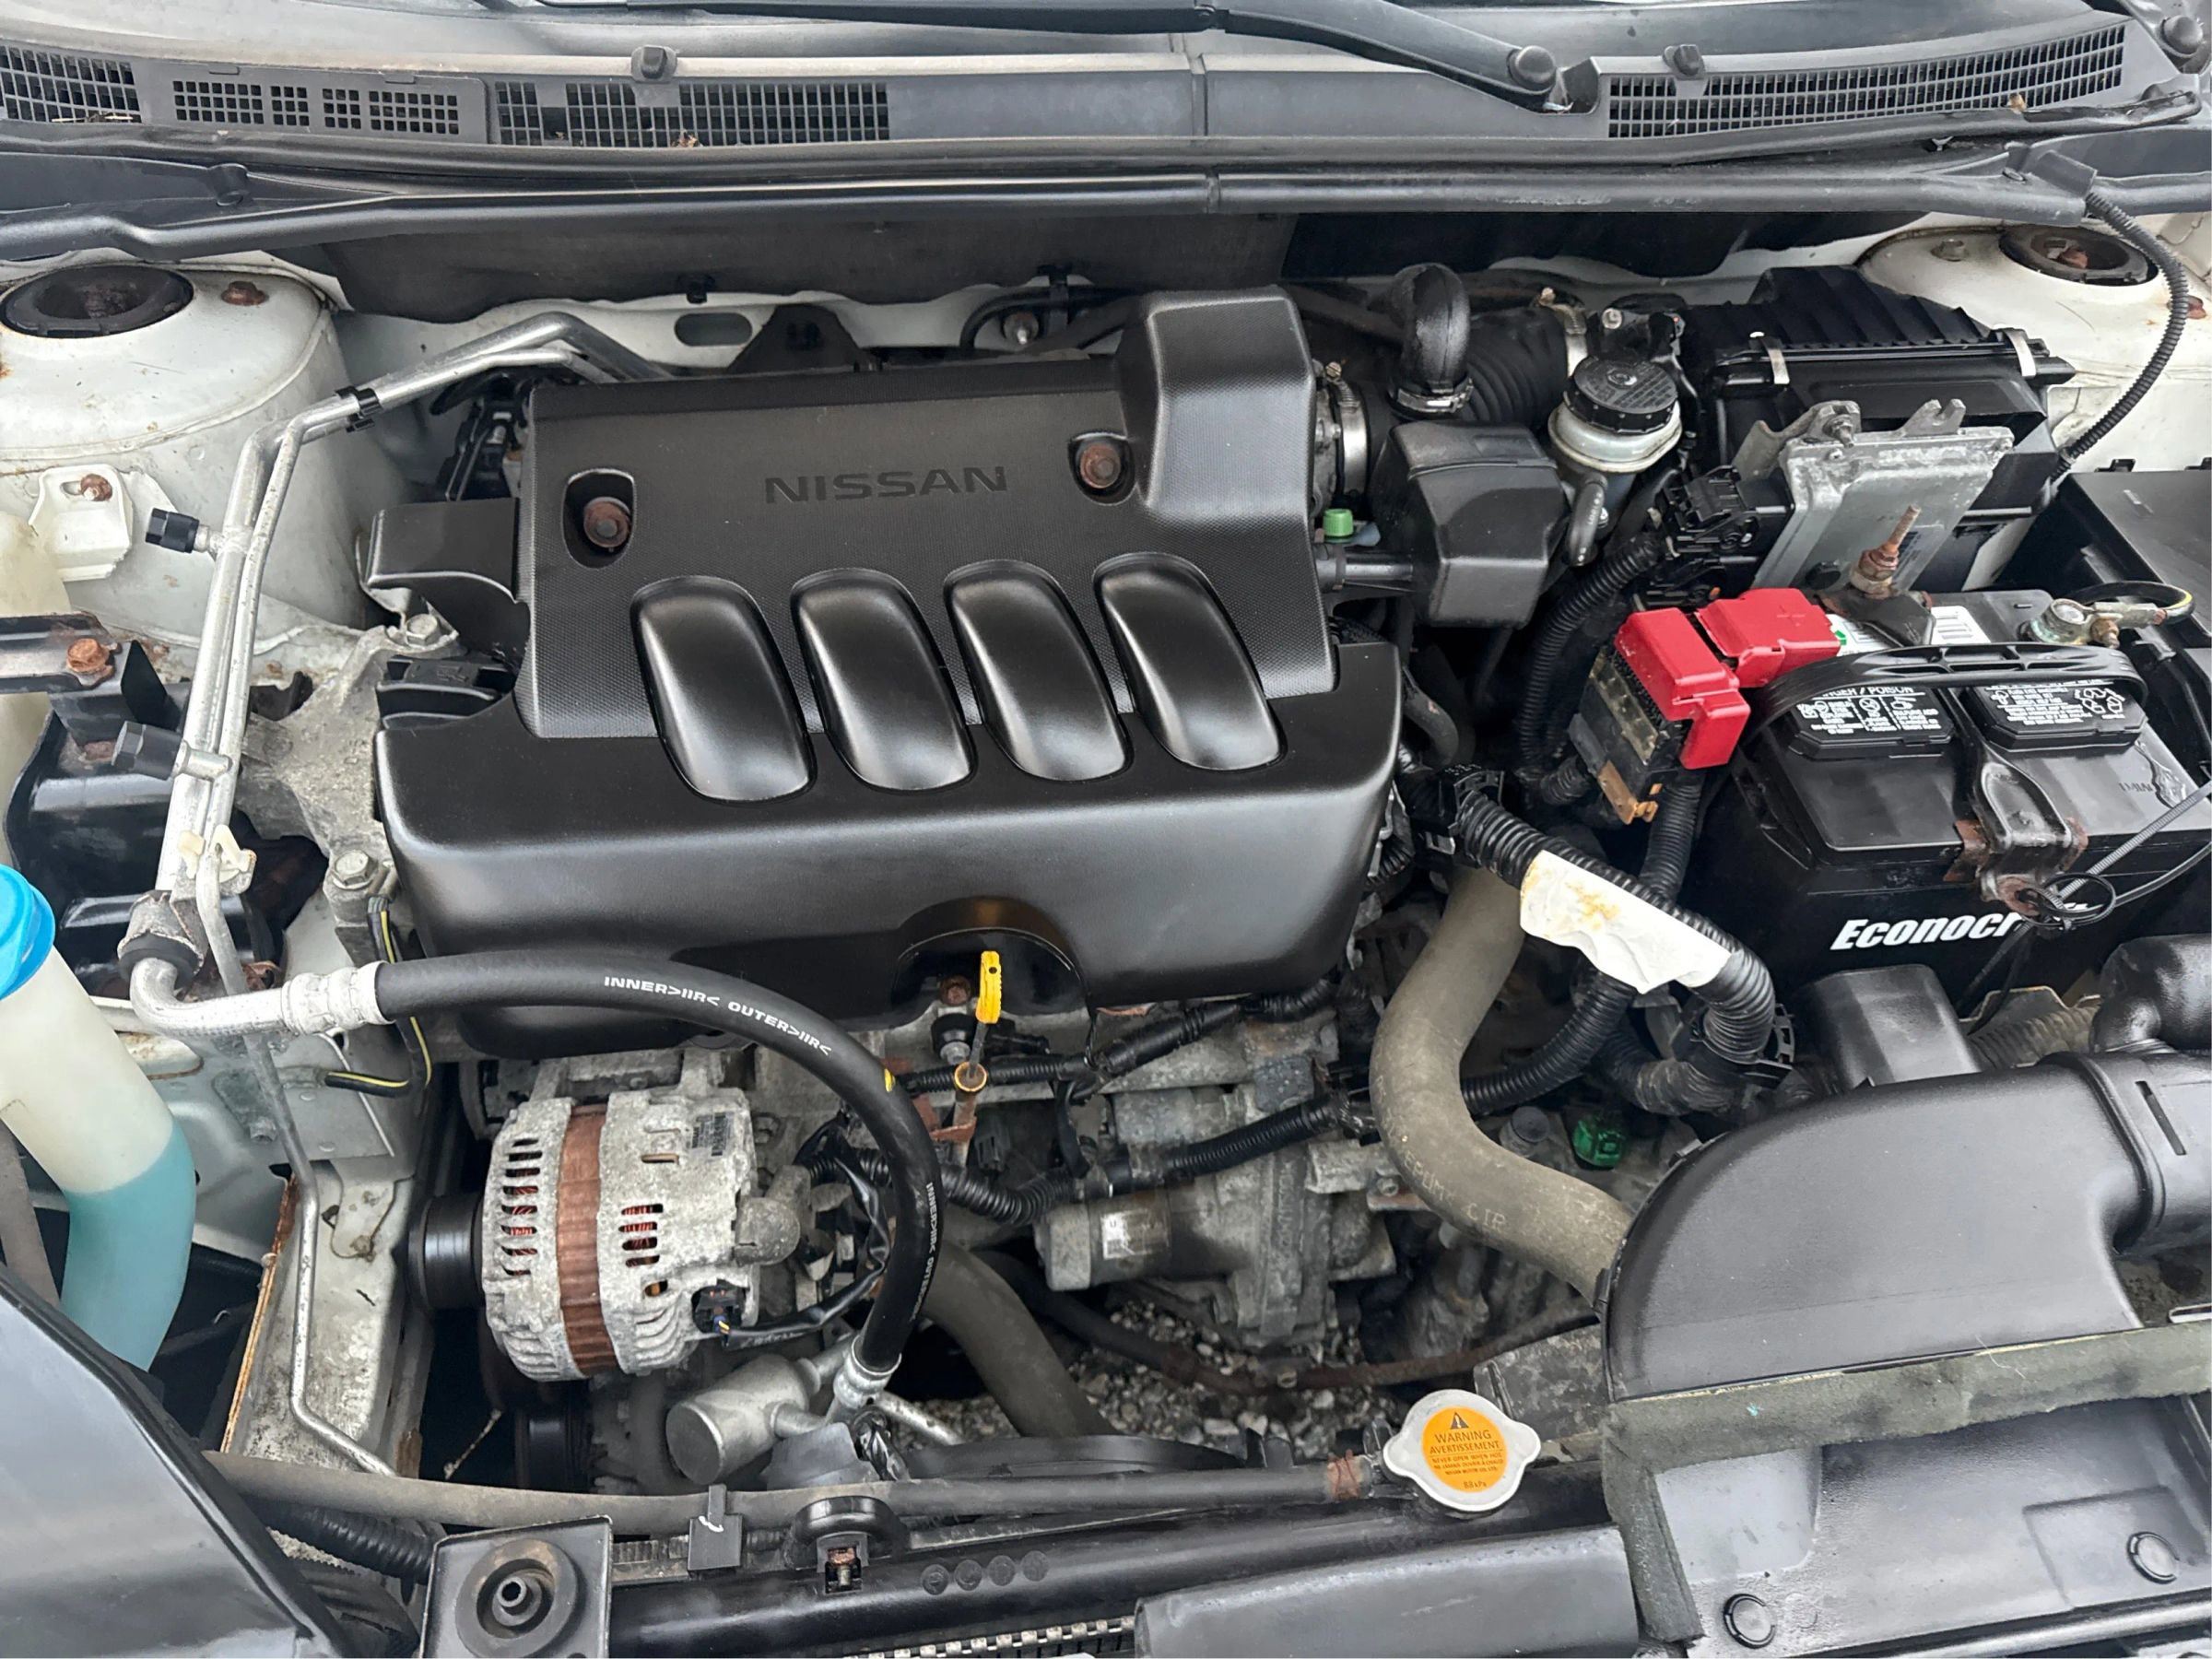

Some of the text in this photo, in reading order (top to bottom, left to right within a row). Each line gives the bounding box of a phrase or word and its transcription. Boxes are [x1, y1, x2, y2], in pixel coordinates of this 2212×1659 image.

[765, 466, 1006, 503] NISSAN
[1830, 902, 2088, 951] Econocr
[1430, 1441, 1500, 1454] AVERTISSEMENT
[1434, 1430, 1492, 1444] WARNING
